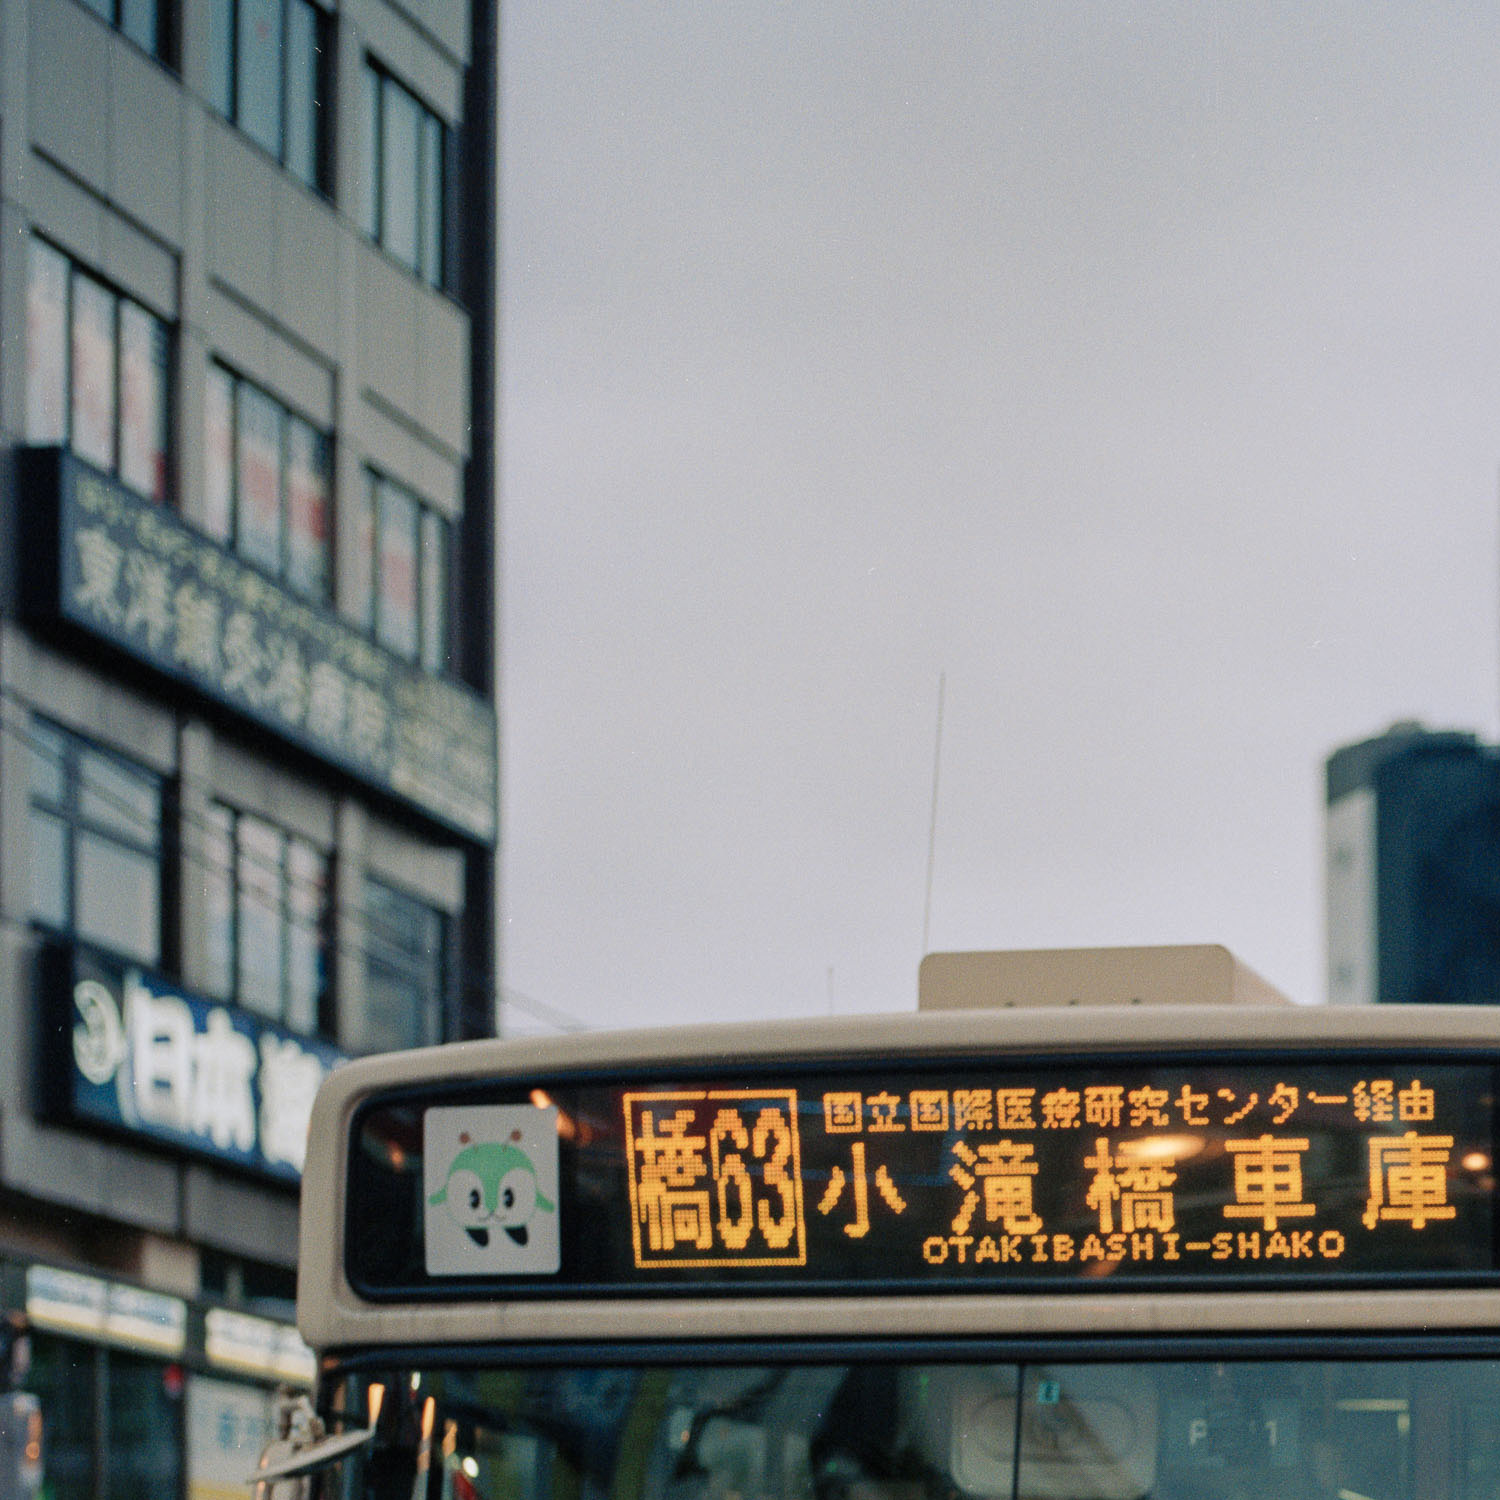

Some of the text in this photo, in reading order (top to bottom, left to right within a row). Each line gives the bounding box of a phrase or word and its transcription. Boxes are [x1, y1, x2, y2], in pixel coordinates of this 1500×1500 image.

[823, 1080, 1436, 1134] 国立国際医療研究センター経由
[635, 1108, 796, 1250] 橋63
[818, 1131, 1457, 1240] 小滝橋車庫
[922, 1230, 1346, 1264] OTAKIBASHI-SHAKO
